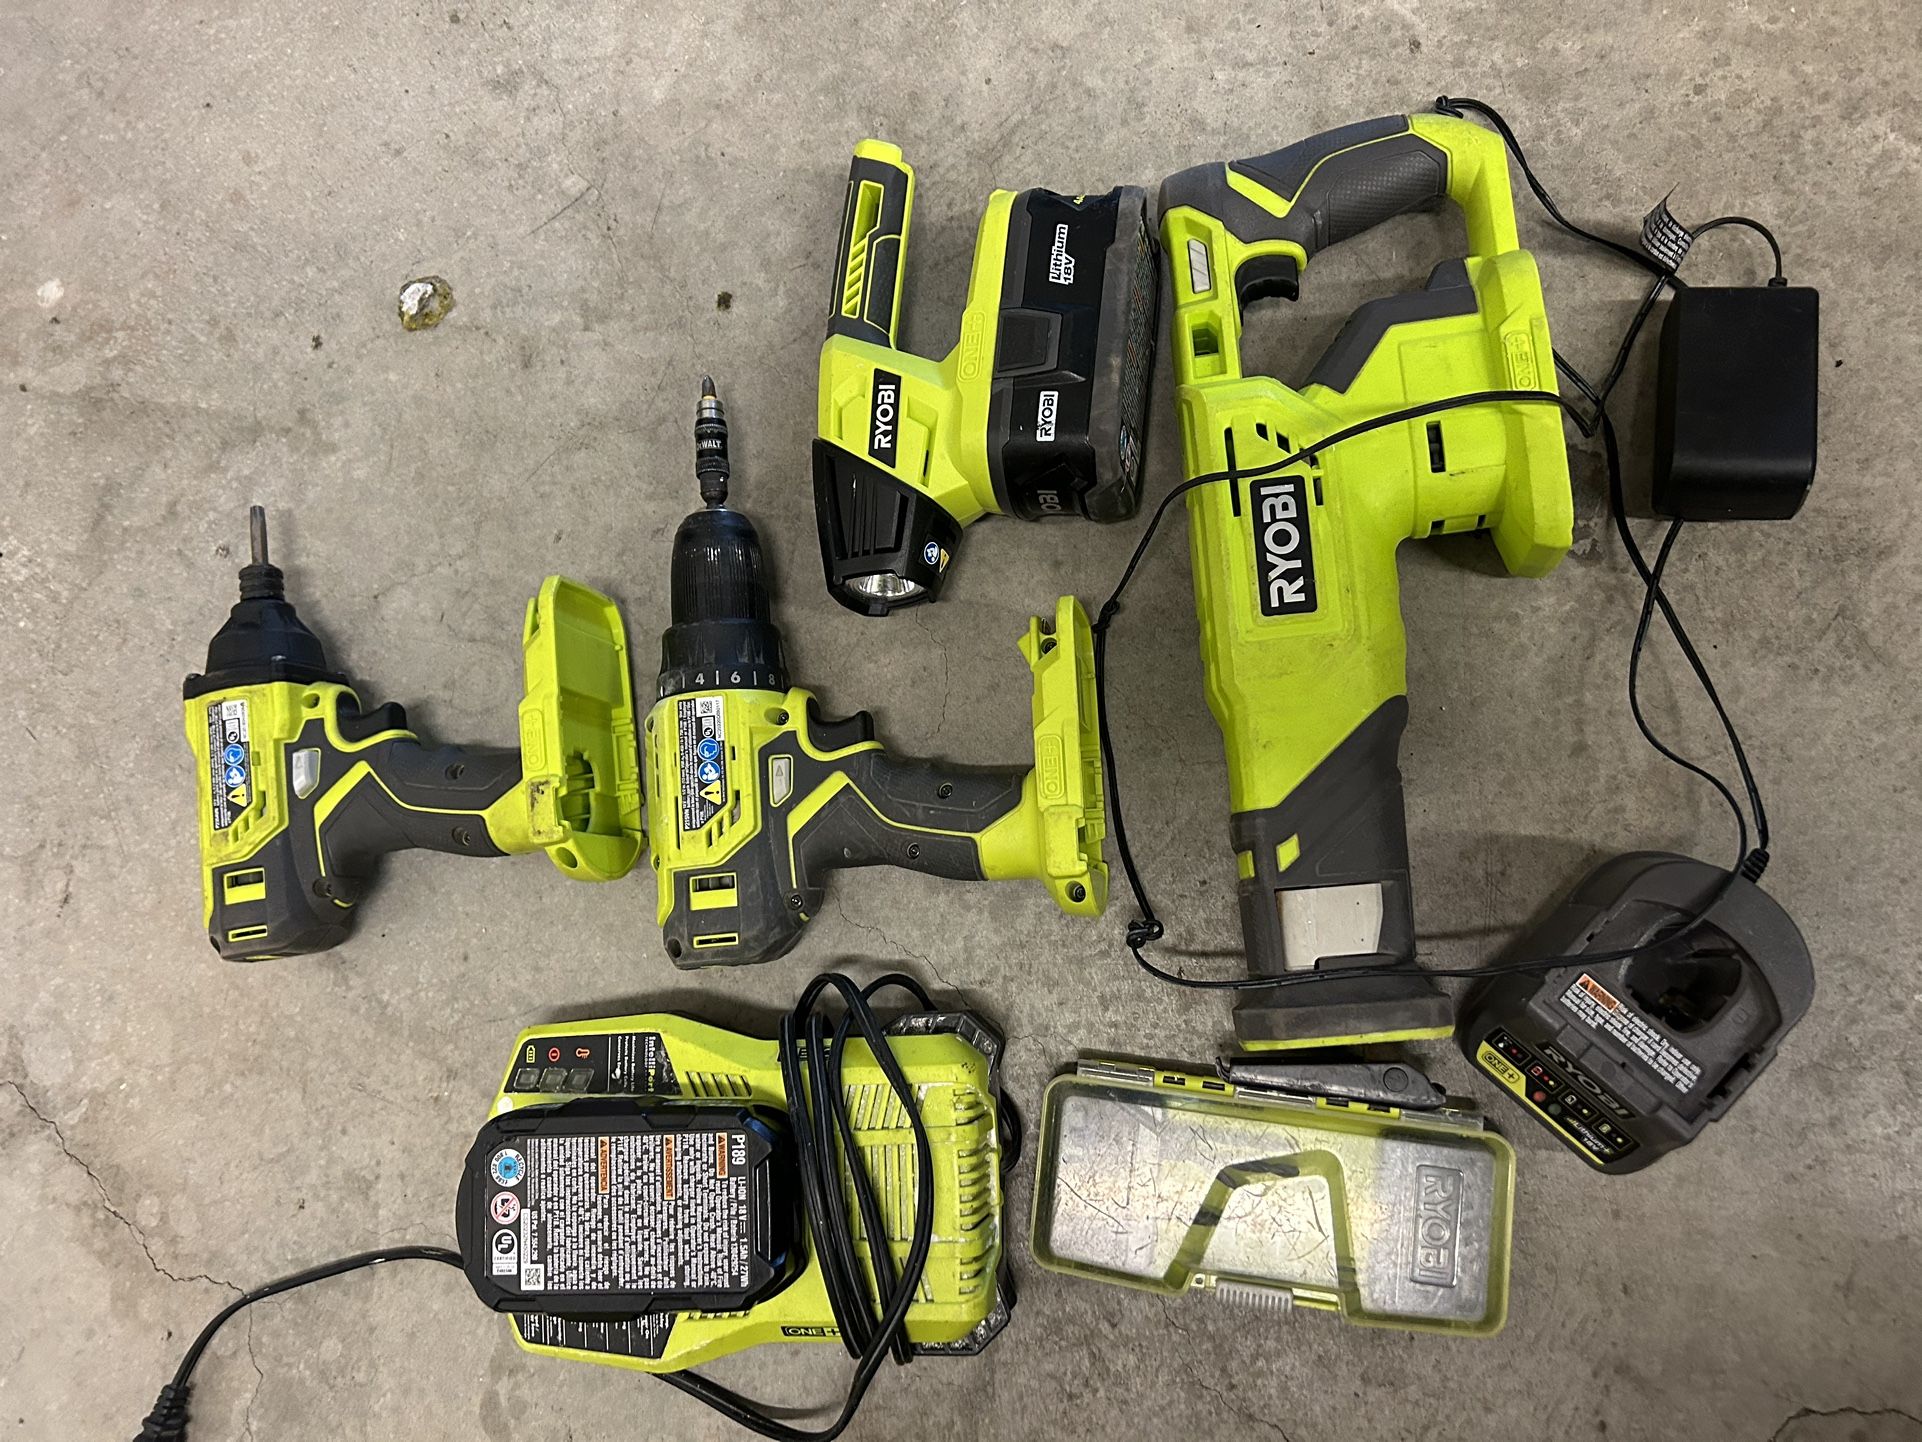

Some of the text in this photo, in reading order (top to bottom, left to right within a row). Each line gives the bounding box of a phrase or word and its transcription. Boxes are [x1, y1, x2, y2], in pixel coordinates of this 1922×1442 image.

[1052, 226, 1066, 280] Lithium
[1064, 256, 1073, 282] 18V
[874, 384, 896, 450] RYOBI
[1040, 394, 1055, 438] RYOBI
[1260, 484, 1306, 608] RYOBI
[695, 671, 776, 686] 4 6 8
[1043, 741, 1060, 795] ONE+
[1484, 1053, 1517, 1081] ONE+
[1543, 1047, 1629, 1116] RYOBI
[718, 1144, 726, 1176] WARNING
[732, 1134, 745, 1165] P189
[738, 1176, 746, 1200] LI-ION
[1419, 1174, 1455, 1280] RYOBI
[497, 1236, 512, 1252] UL
[740, 1238, 748, 1260] 1.5Ah
[740, 1266, 748, 1287] 27Wh
